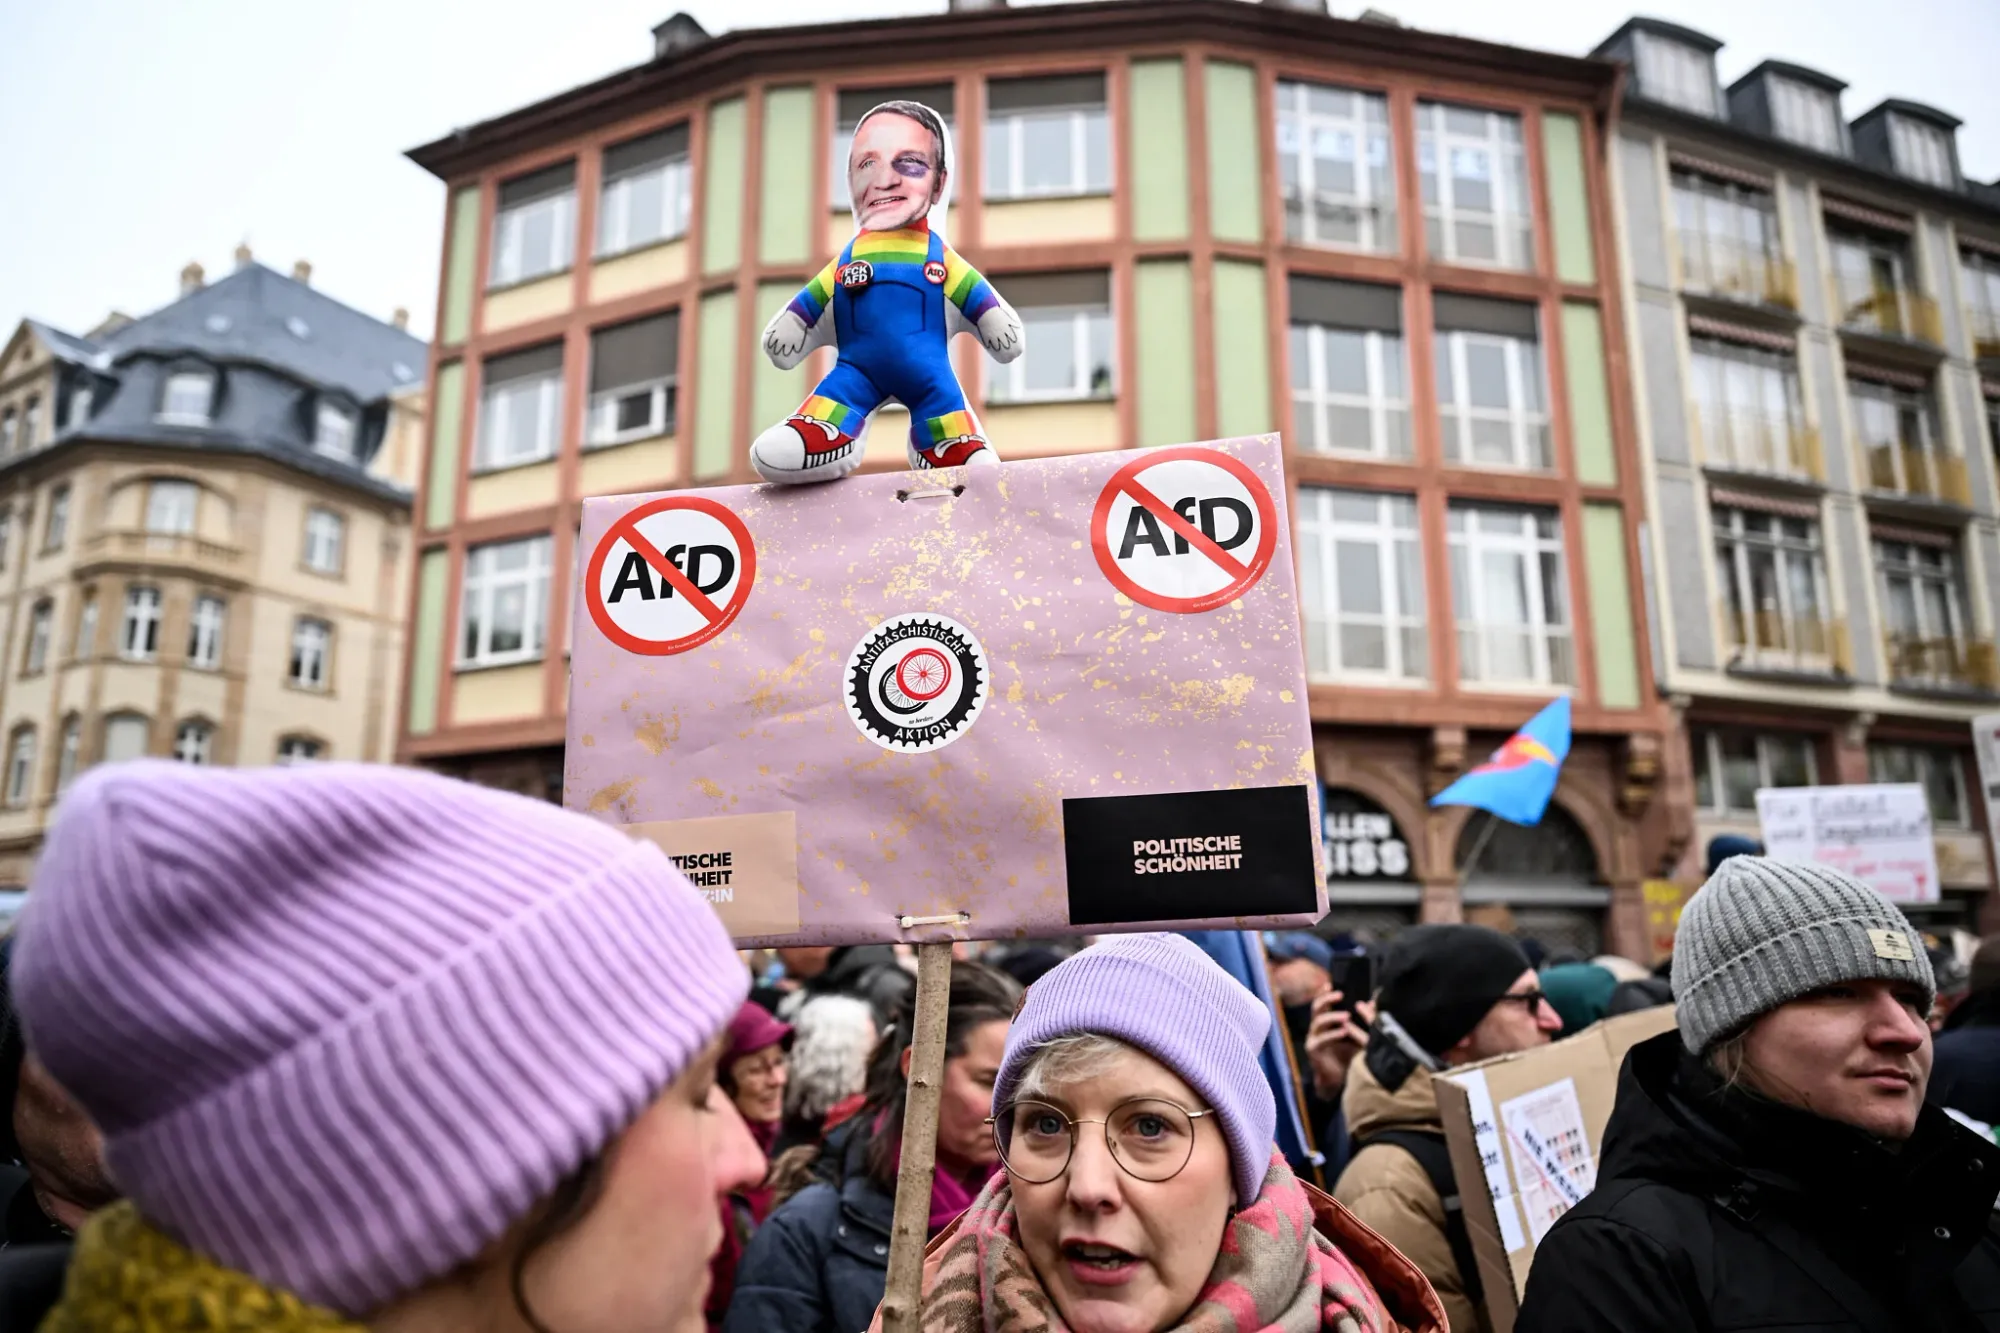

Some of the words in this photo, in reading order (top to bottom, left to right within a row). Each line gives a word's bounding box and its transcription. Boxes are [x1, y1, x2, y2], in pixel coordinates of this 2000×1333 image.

[844, 264, 868, 277] FCK
[844, 274, 868, 286] AFD
[1118, 497, 1253, 559] AfD
[607, 544, 735, 603] AfD
[860, 626, 966, 673] ANTIFASCHISTISCHE
[894, 718, 951, 739] AKTION
[1133, 835, 1241, 855] POLITISCHE
[1134, 853, 1242, 874] SCHÖNHEIT
